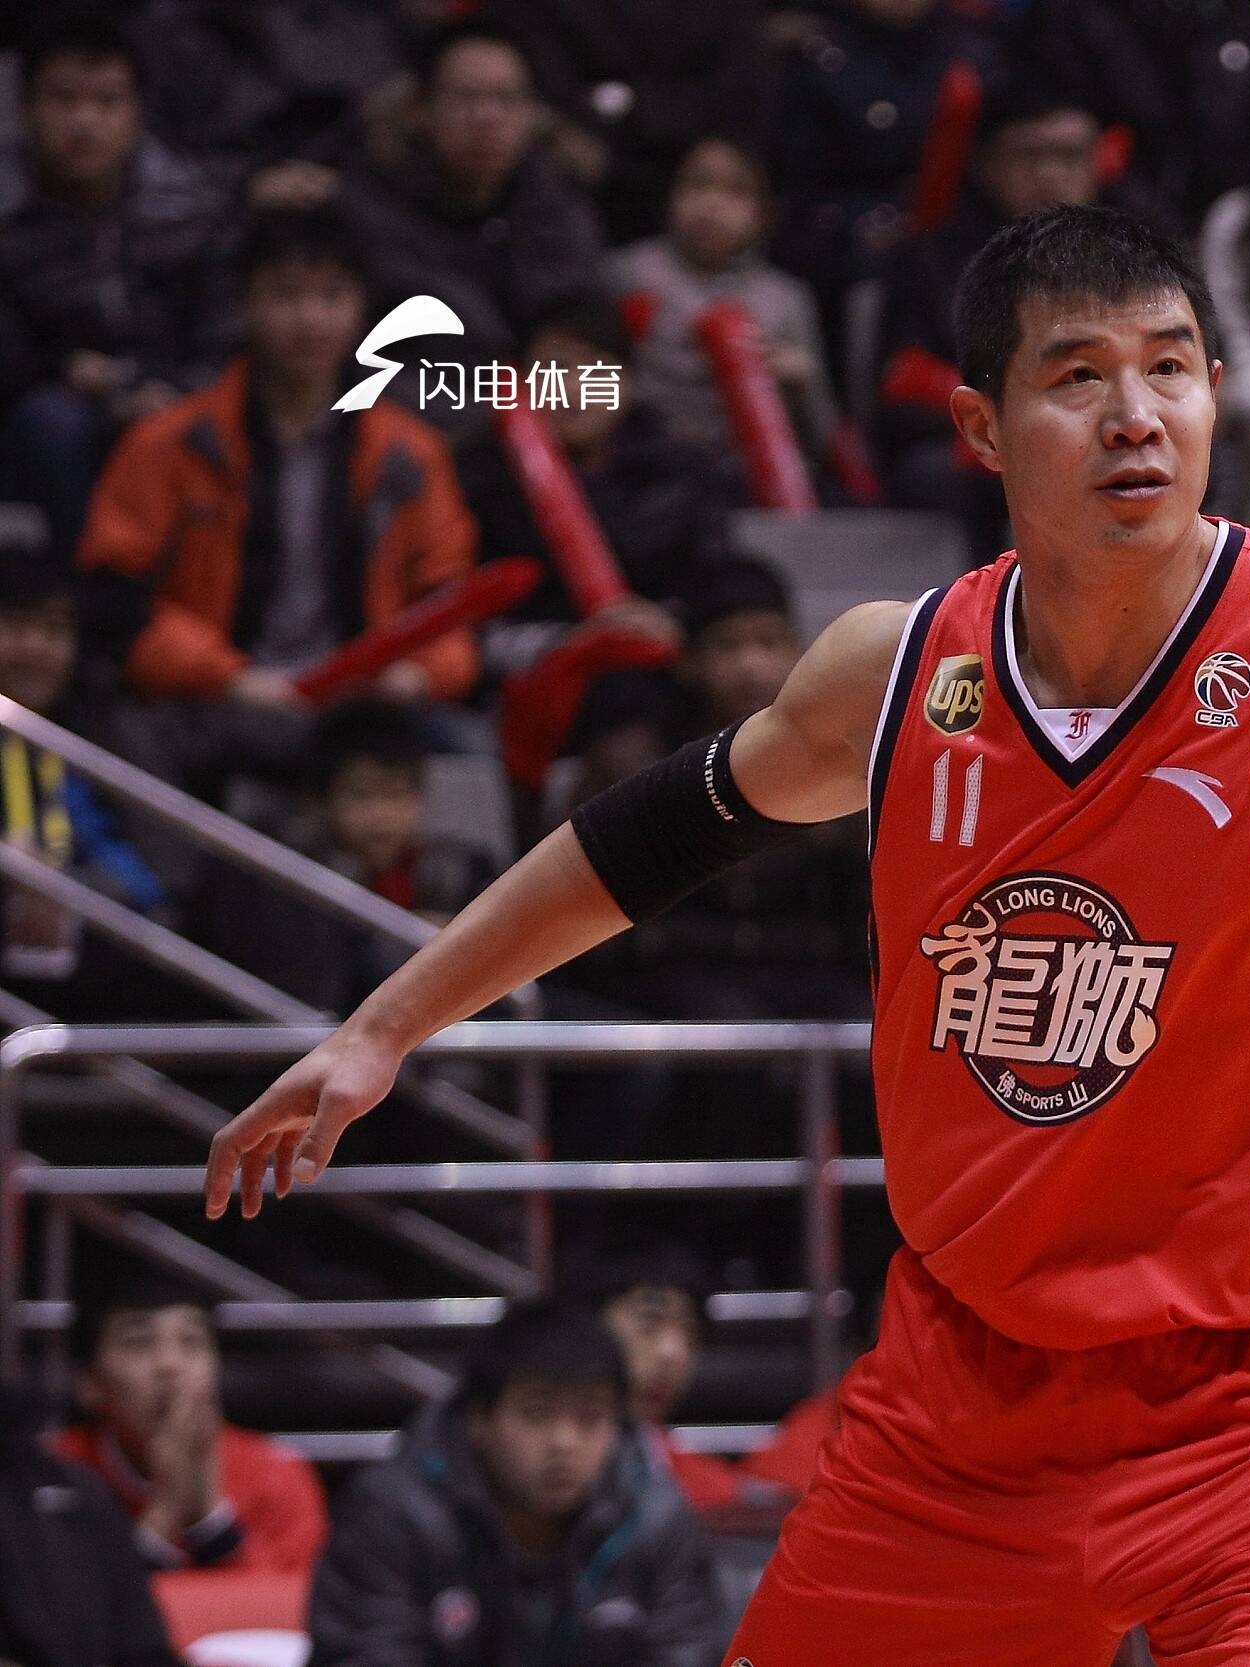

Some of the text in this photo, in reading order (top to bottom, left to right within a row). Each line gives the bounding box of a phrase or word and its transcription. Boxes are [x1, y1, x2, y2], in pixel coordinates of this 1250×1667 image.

[1196, 710, 1238, 727] CBA
[929, 748, 984, 847] 11
[996, 888, 1116, 939] LONG LIONS
[921, 902, 1172, 1068] 龍獅
[1015, 1087, 1064, 1110] SPORTS
[1067, 1081, 1089, 1107] 山
